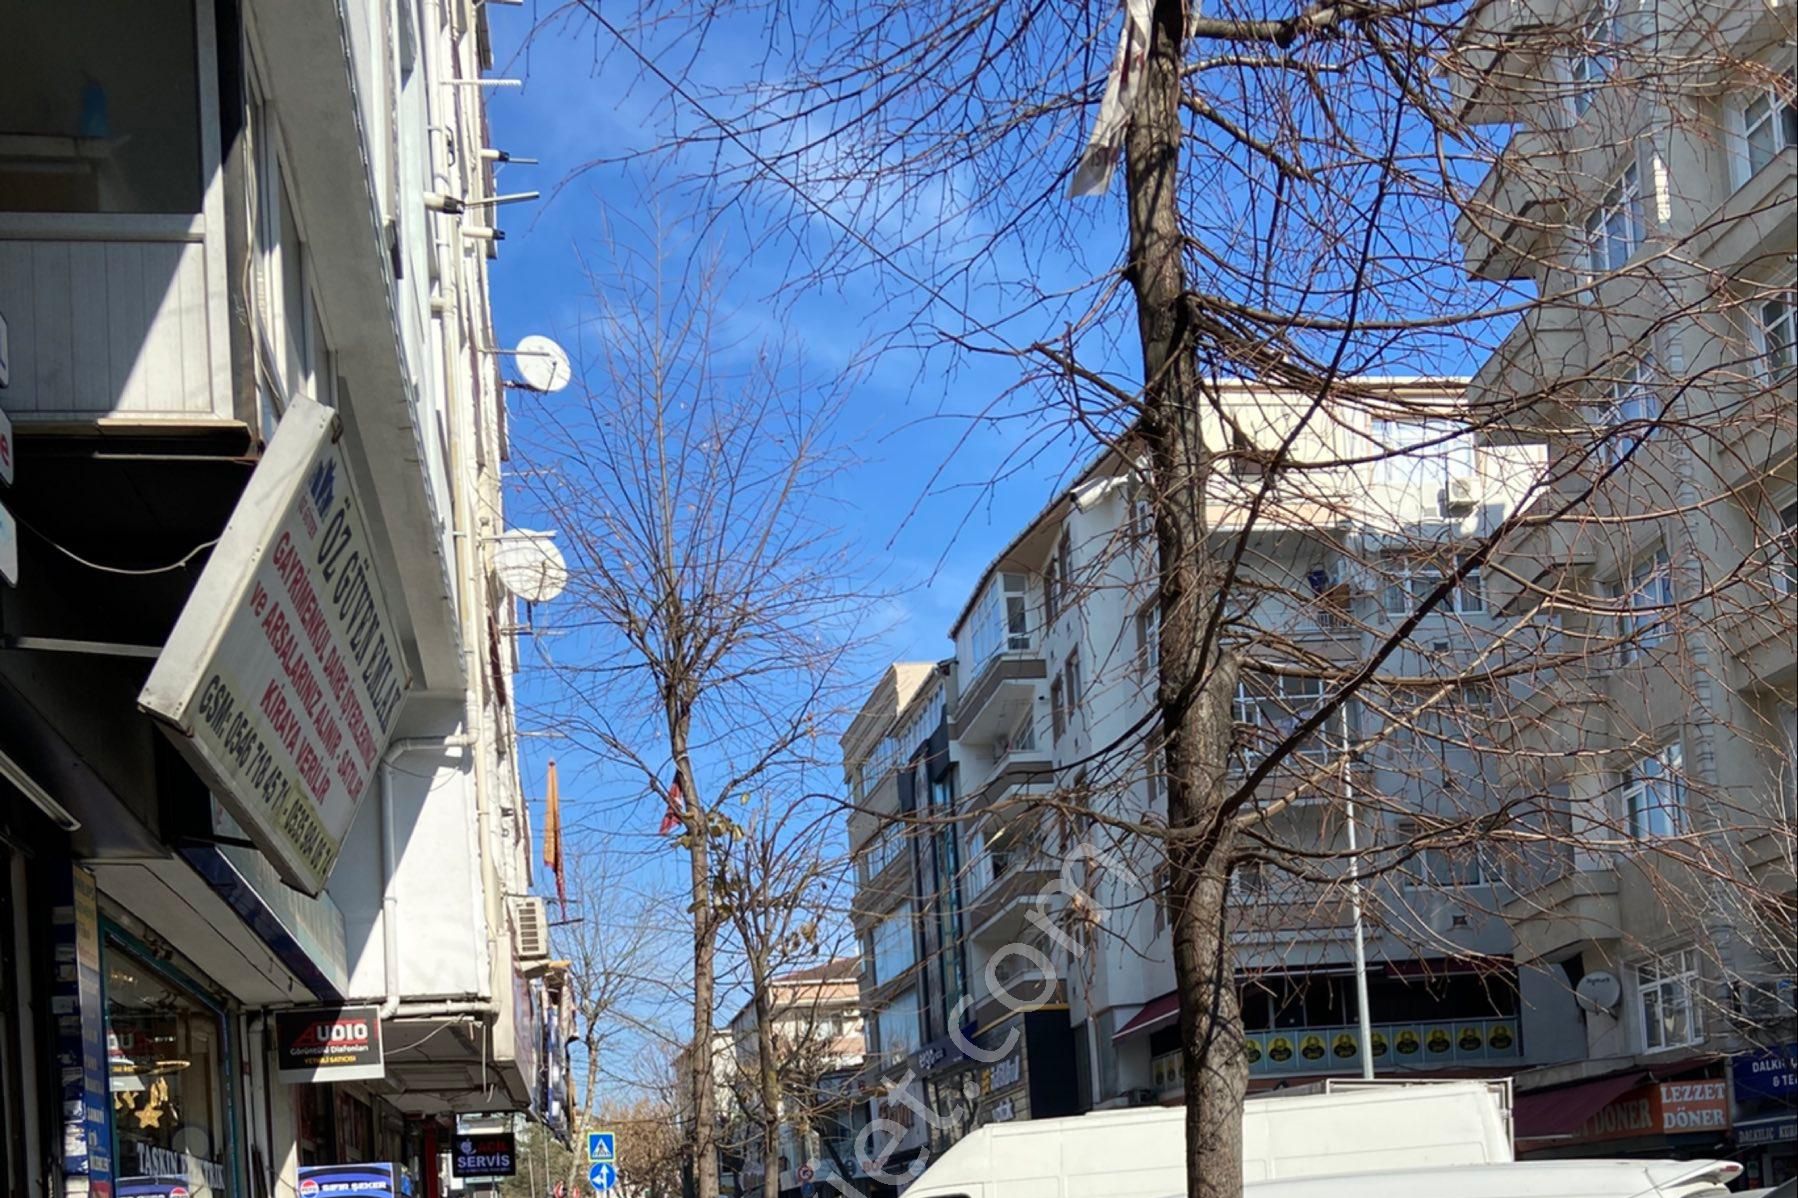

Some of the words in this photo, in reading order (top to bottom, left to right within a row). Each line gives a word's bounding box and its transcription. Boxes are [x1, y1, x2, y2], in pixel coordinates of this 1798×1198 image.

[317, 496, 352, 584] ÖZ
[272, 531, 332, 664] GAYRİMENKUL
[323, 645, 349, 702] DAİRE
[333, 551, 380, 666] GÜVEN
[250, 580, 268, 617] ve
[261, 602, 323, 719] ARSALARINIZ
[312, 703, 343, 761] ALINIR
[337, 749, 364, 806] SATILIR
[362, 633, 402, 735] EMLAK
[198, 674, 232, 739] GSM:
[224, 711, 257, 769] 0546
[245, 742, 272, 790] 718
[263, 766, 283, 804] 45
[260, 678, 301, 757] KİRAYA
[296, 736, 331, 806] VERİLİR
[1660, 1083, 1726, 1104] LEZZET
[1663, 1107, 1726, 1129] DÖNER
[457, 1152, 510, 1168] SERVİS
